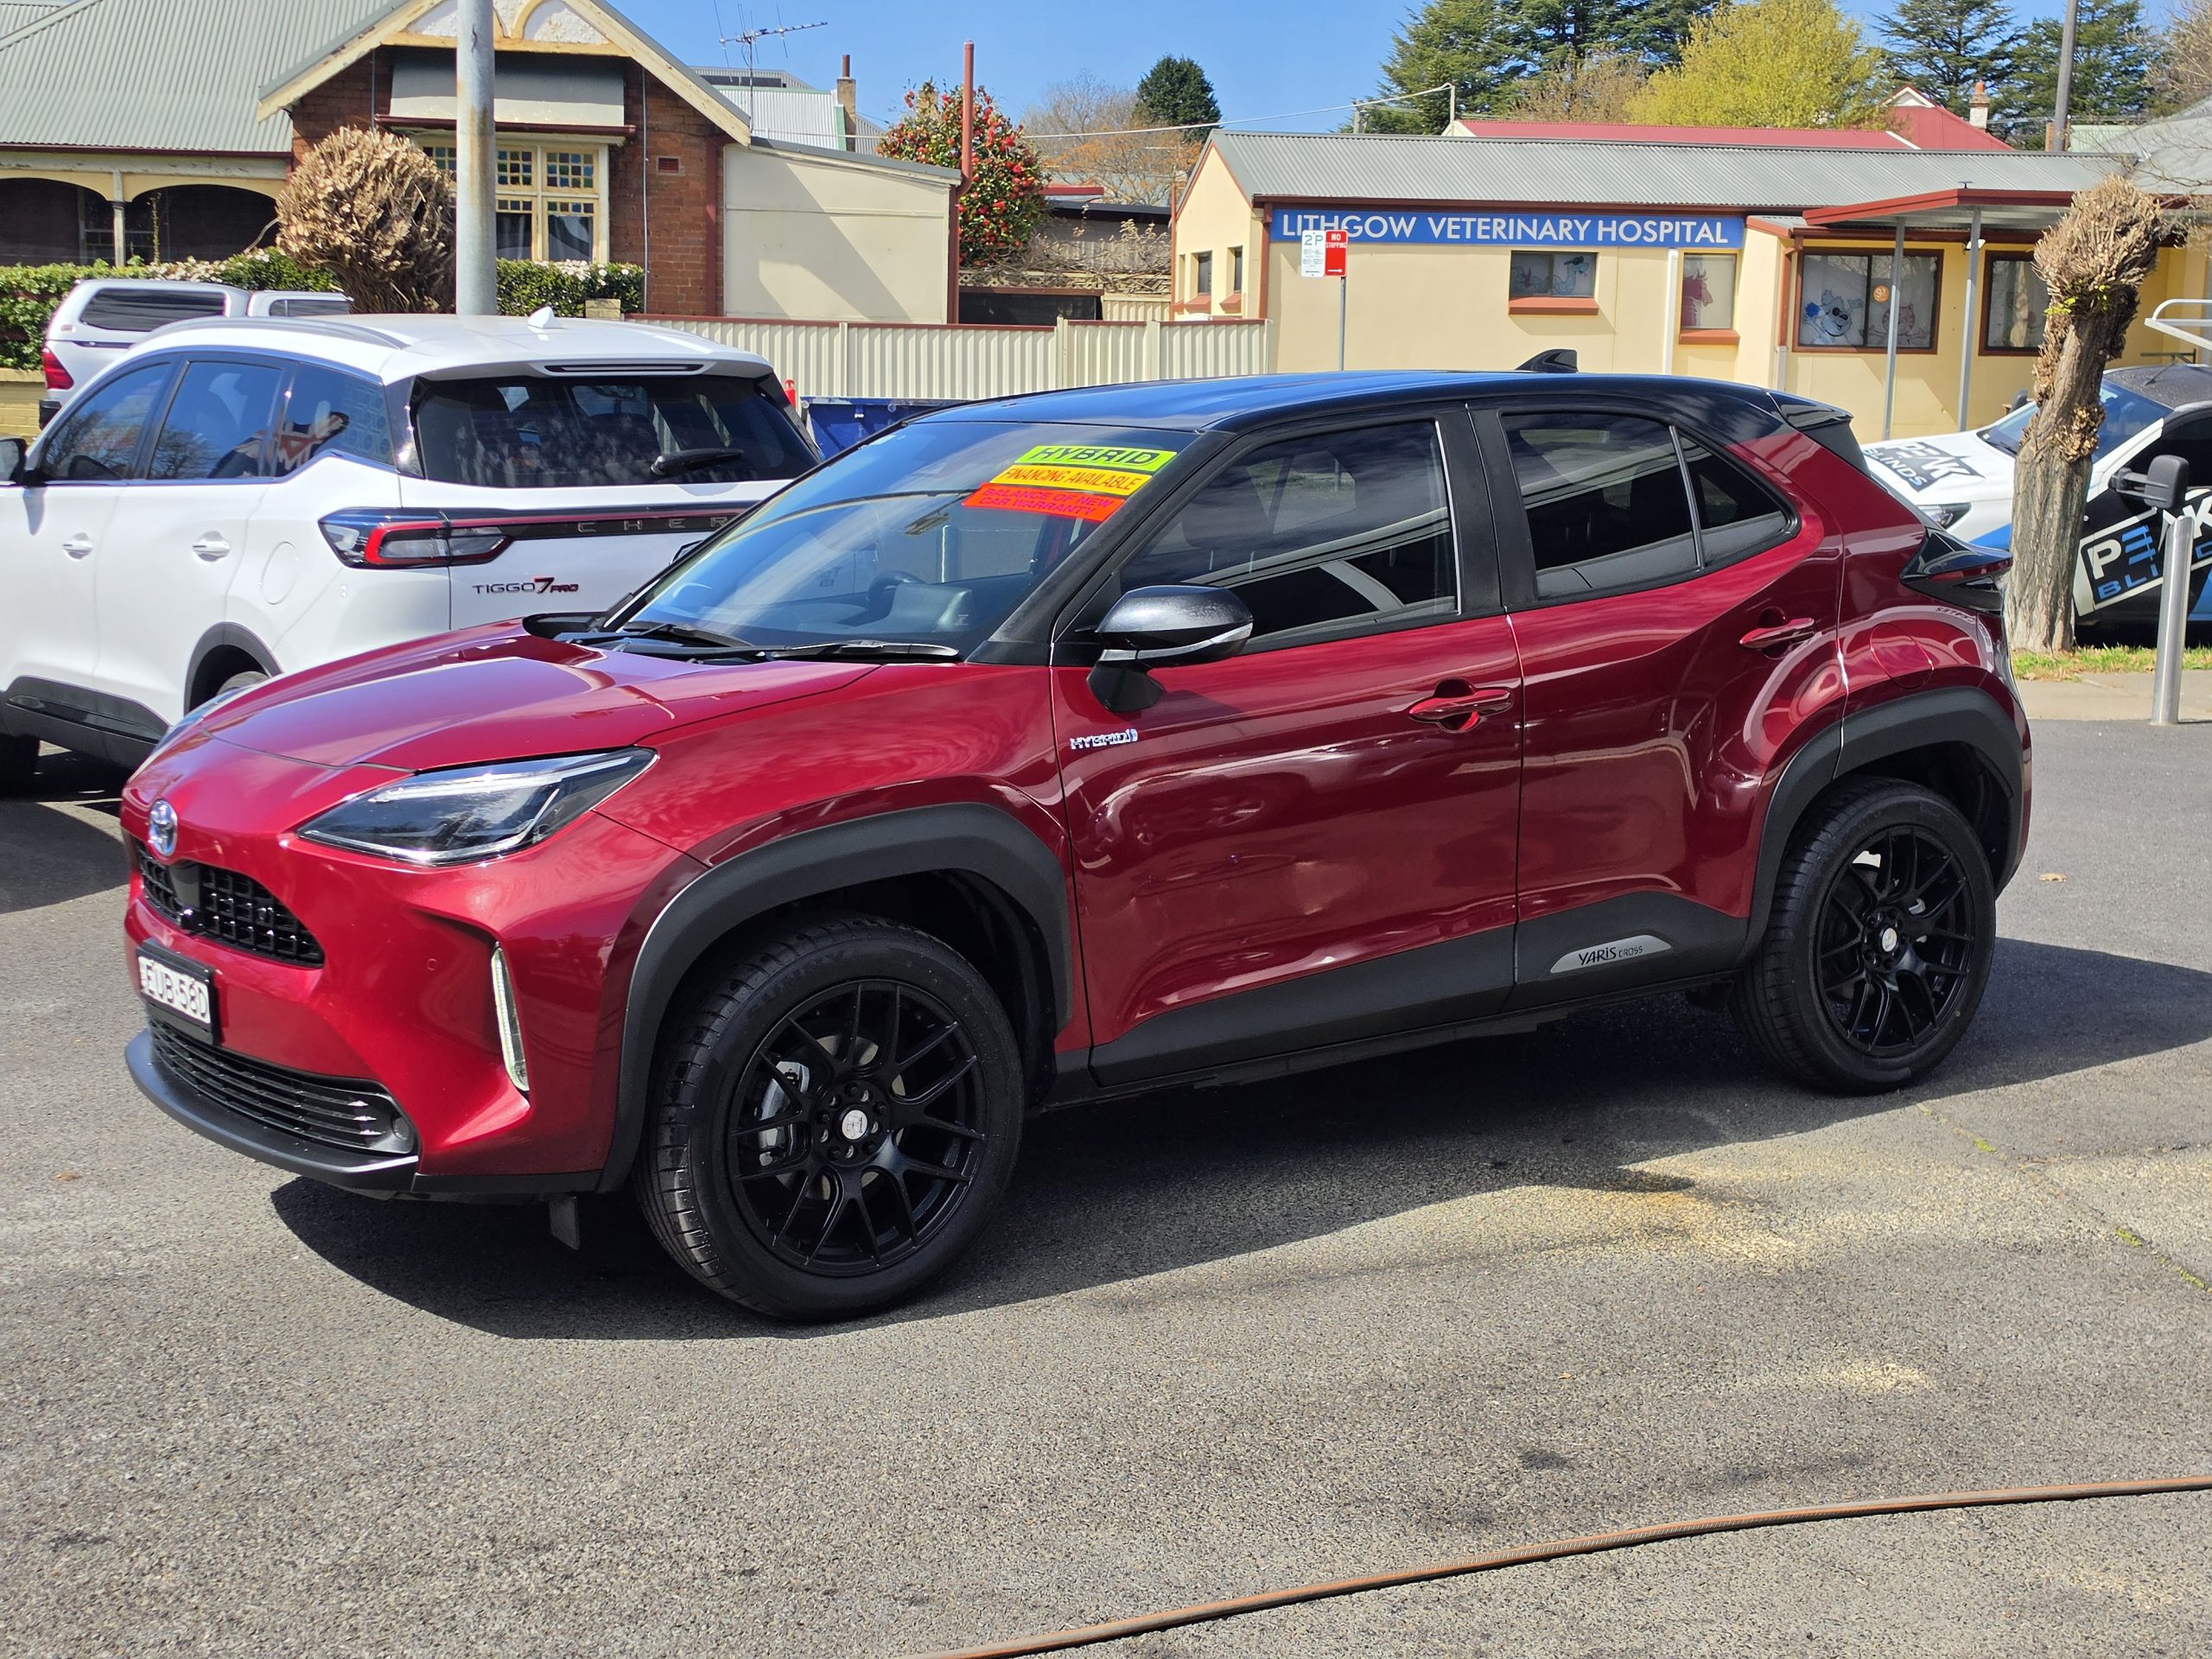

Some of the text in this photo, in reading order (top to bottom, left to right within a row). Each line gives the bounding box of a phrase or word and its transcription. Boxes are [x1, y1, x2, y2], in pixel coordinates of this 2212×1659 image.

[1282, 213, 1729, 244] LITHGOW VETERINARY HOSPITAL
[1304, 234, 1324, 246] 2P
[1029, 447, 1160, 465] HYBRID
[1862, 448, 1929, 486] BLINDS
[1004, 468, 1142, 491] FINANCING AVAILABLE
[980, 497, 1097, 515] CAR WARRANTY
[983, 488, 1114, 508] BALANCE OF NEW
[1070, 729, 1132, 750] HYBRID
[1618, 945, 1643, 958] CROSS
